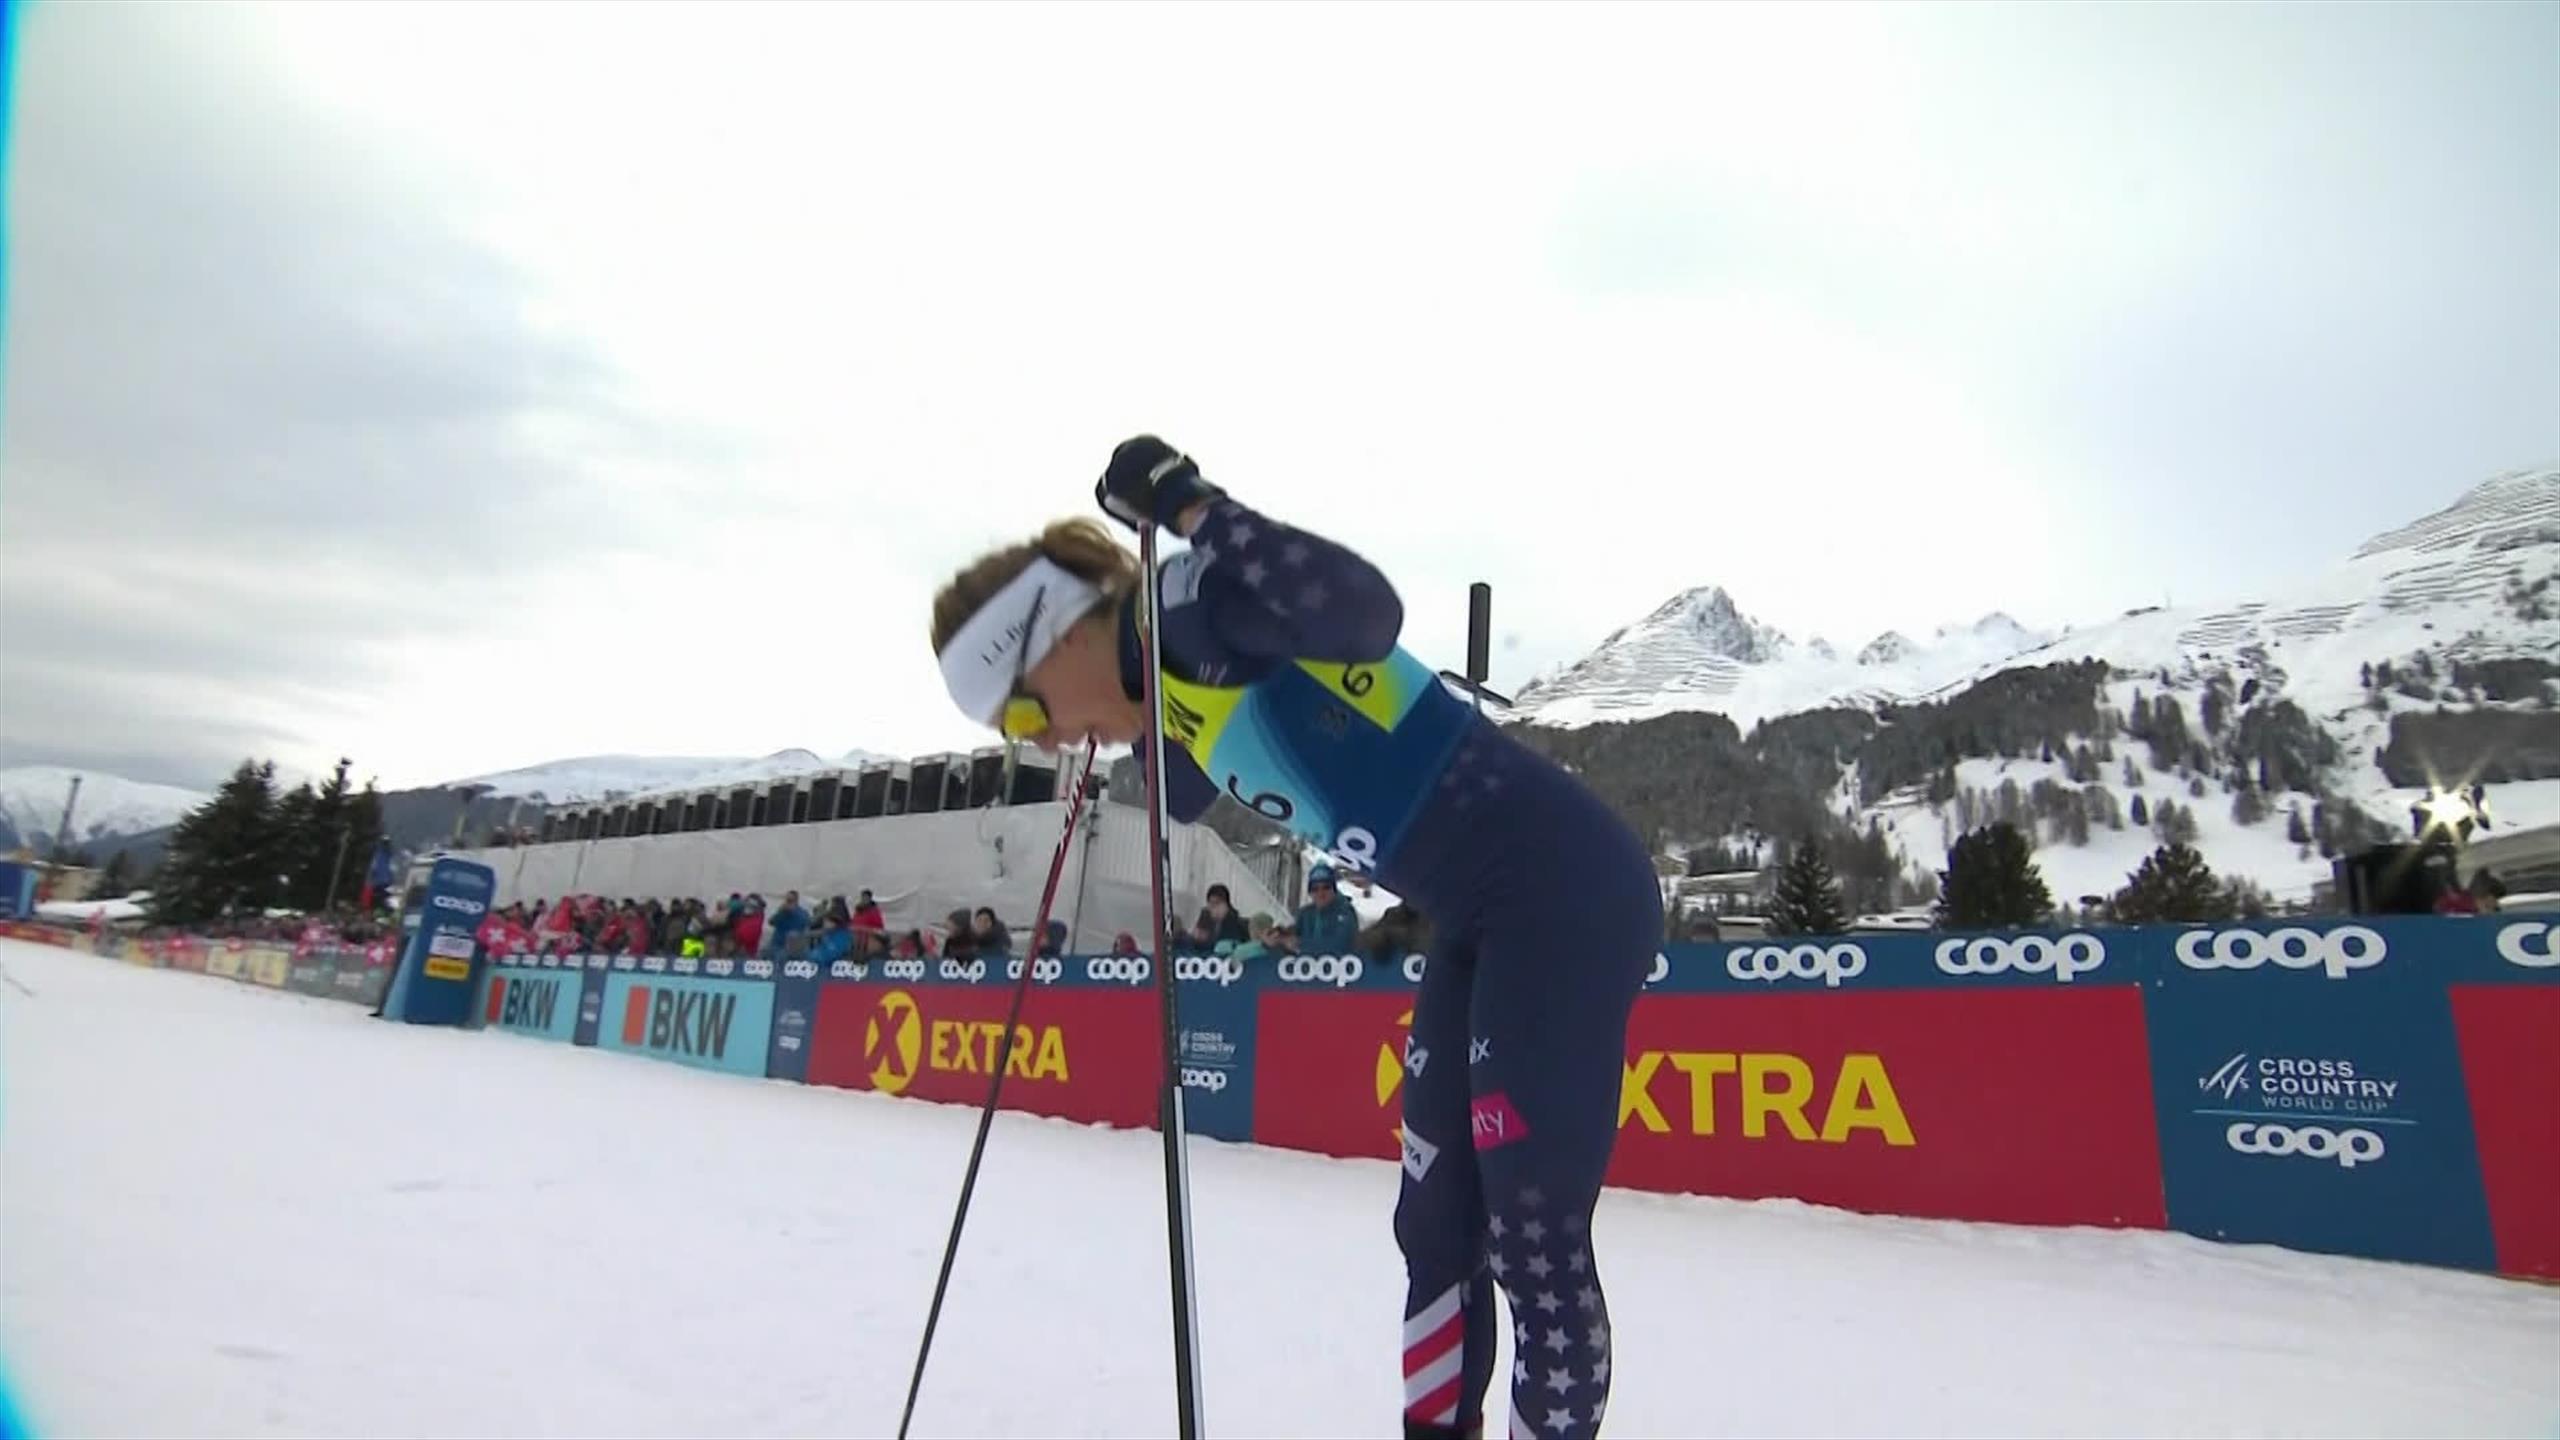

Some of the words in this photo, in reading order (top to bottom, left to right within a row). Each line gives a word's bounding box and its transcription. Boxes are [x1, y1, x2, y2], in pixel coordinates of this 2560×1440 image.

[1341, 663, 1374, 698] 6
[1227, 774, 1293, 822] 6
[433, 895, 485, 915] coop
[1726, 943, 1867, 987] coop
[1935, 933, 2105, 982] coop
[2175, 925, 2387, 979] coop
[883, 960, 925, 982] coop
[1007, 958, 1062, 985] cop
[1087, 957, 1150, 985] coop
[1175, 956, 1243, 987] coop
[1277, 954, 1363, 988] coop
[504, 978, 560, 1031] BKW
[650, 987, 736, 1059] BKW
[930, 1019, 1068, 1082] EXTRA
[1181, 1068, 1227, 1093] coop
[2258, 1058, 2355, 1078] CROSS
[1617, 1051, 1917, 1146] XTRA
[2260, 1077, 2398, 1098] COUNTRY
[2262, 1096, 2334, 1111] WORLD
[2345, 1097, 2388, 1112] CUP
[2226, 1122, 2385, 1167] coop
